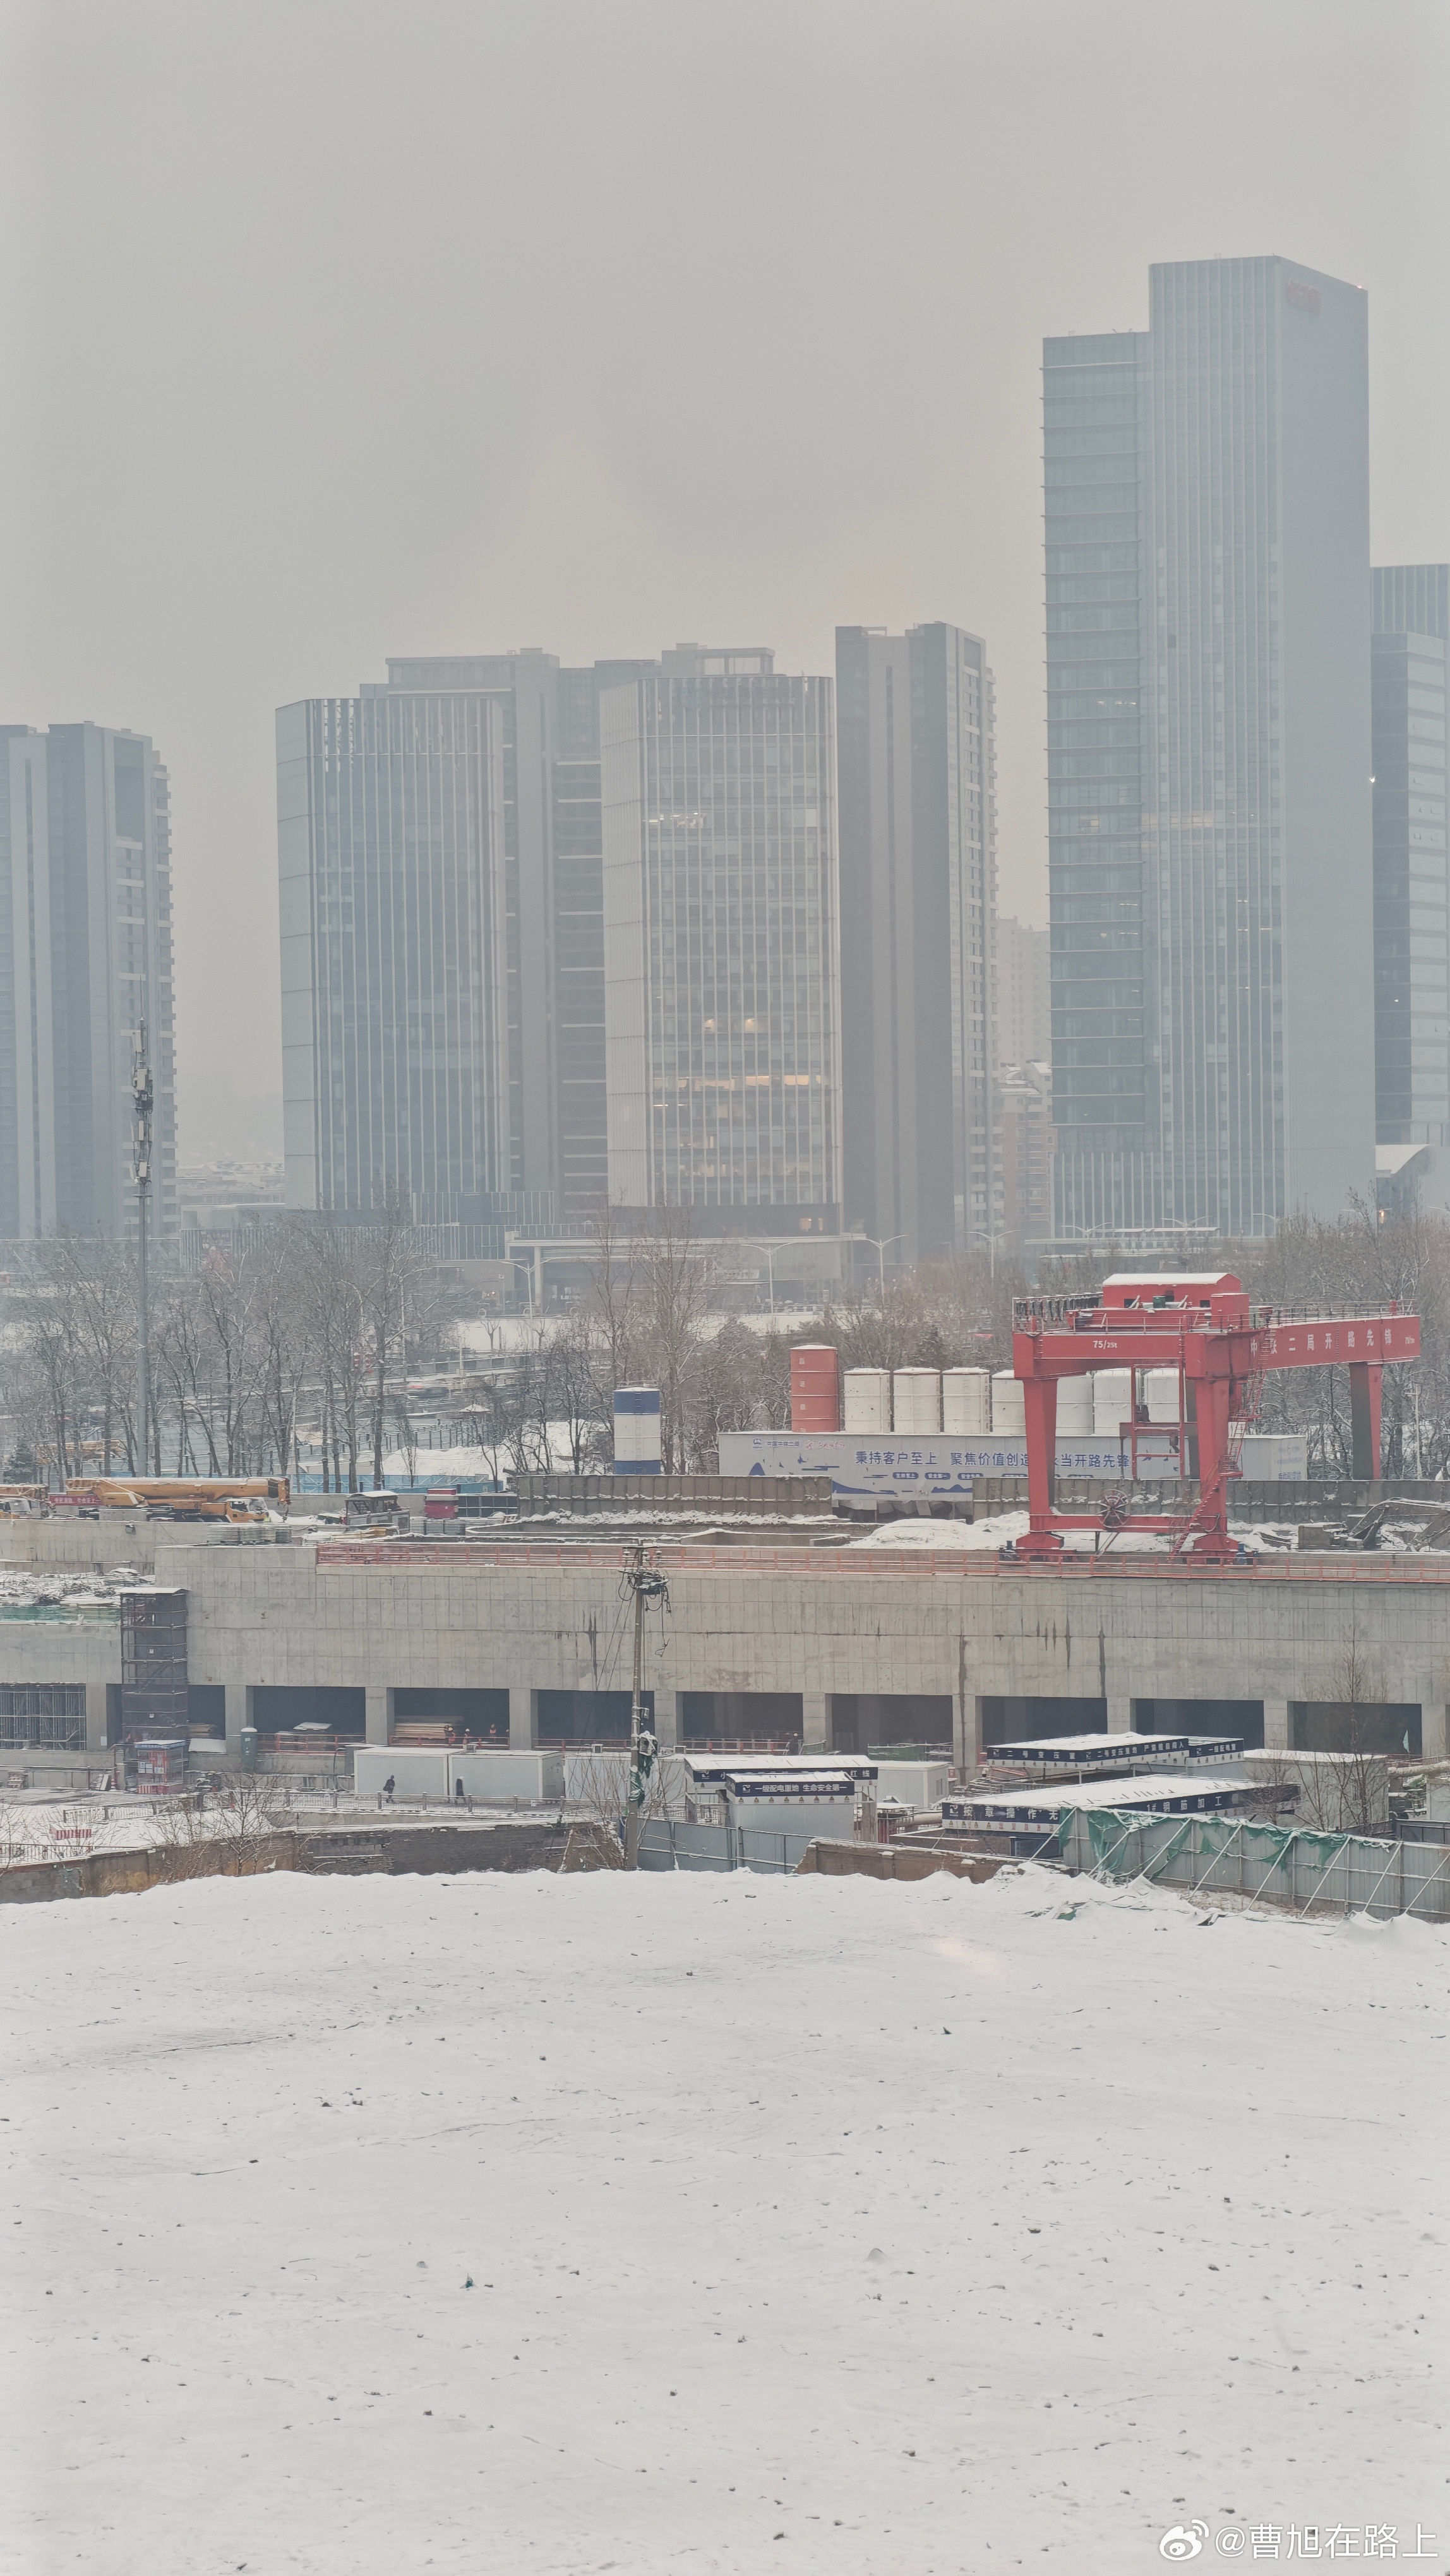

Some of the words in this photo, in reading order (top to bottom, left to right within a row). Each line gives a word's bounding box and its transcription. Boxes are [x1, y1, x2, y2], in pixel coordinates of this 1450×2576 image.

[855, 1451, 938, 1465] 秉持客户至上
[950, 1452, 1029, 1467] 聚焦价值创造
[803, 1784, 848, 1792] 生命安全第一
